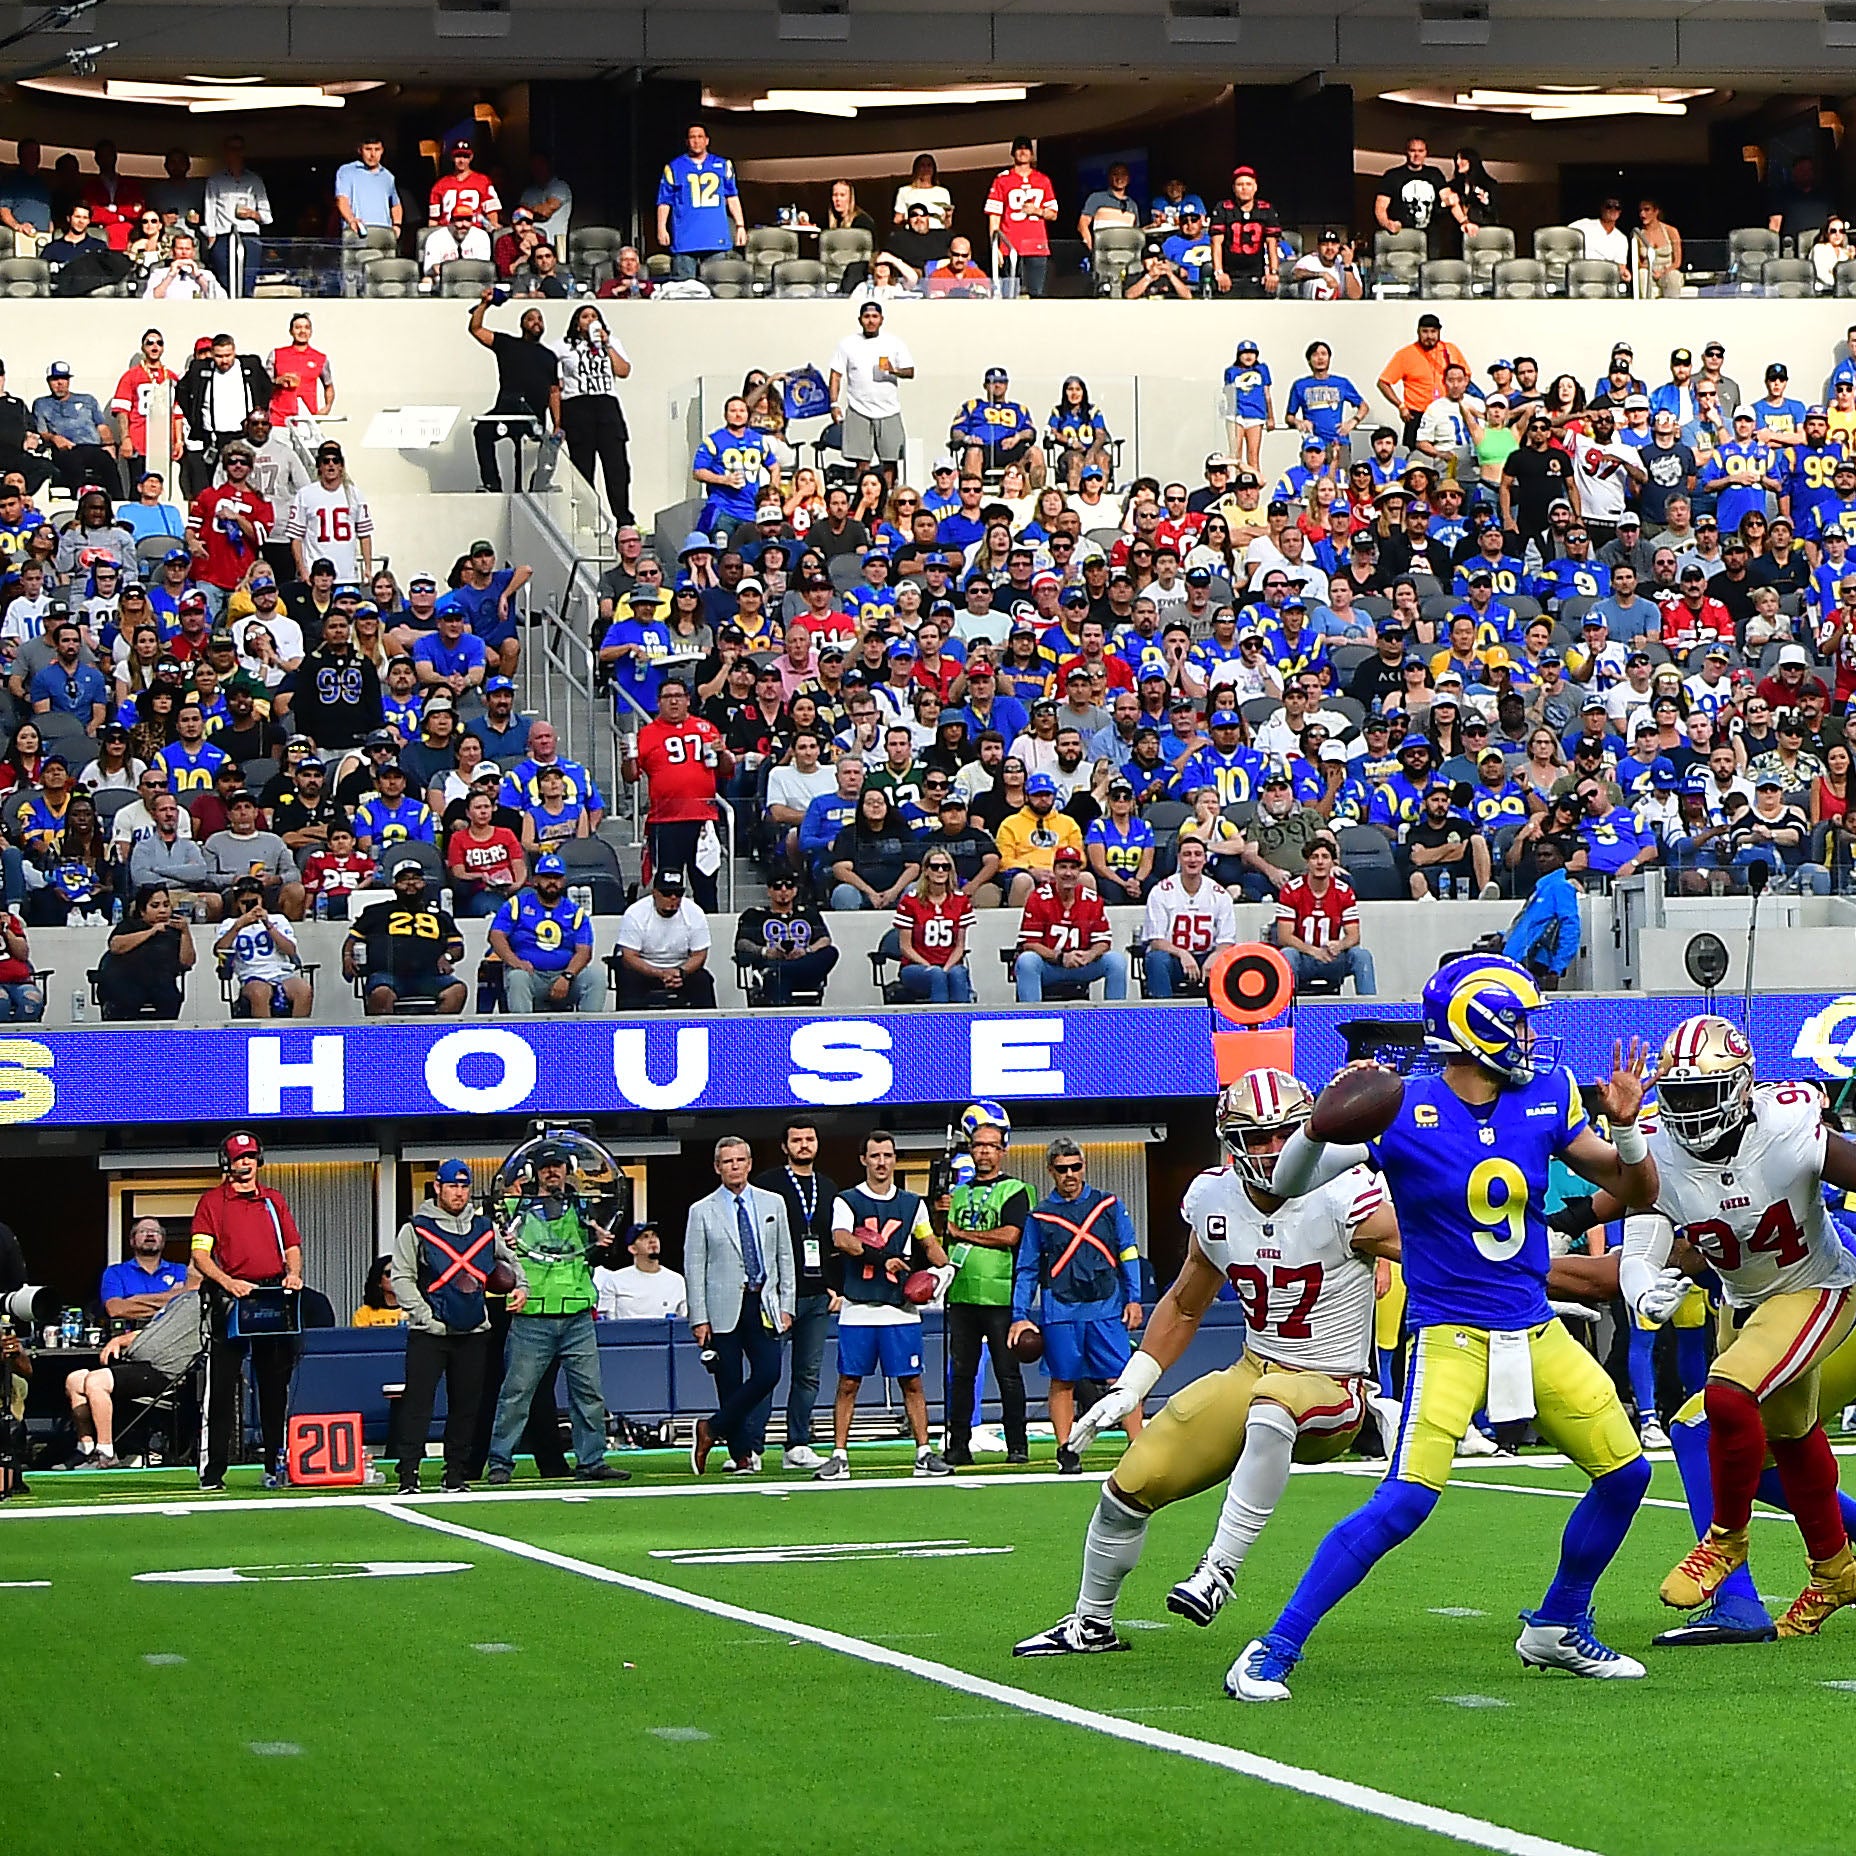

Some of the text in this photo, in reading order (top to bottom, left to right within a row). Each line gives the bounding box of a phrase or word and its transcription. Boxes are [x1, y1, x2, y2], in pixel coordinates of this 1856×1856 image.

[689, 175, 720, 208] 12
[1231, 223, 1263, 252] 13
[1804, 457, 1836, 488] 99
[317, 509, 352, 542] 16
[666, 736, 701, 762] 97
[1217, 767, 1249, 802] 10
[235, 932, 274, 961] 99
[537, 921, 561, 950] 9
[925, 920, 953, 946] 85
[1172, 915, 1211, 951] 85
[1303, 916, 1331, 947] 11
[247, 1017, 1065, 1115] HOUSE
[1467, 1158, 1529, 1261] 9
[1687, 1201, 1809, 1270] 94
[1227, 1262, 1324, 1338] 97
[299, 1423, 354, 1472] 20
